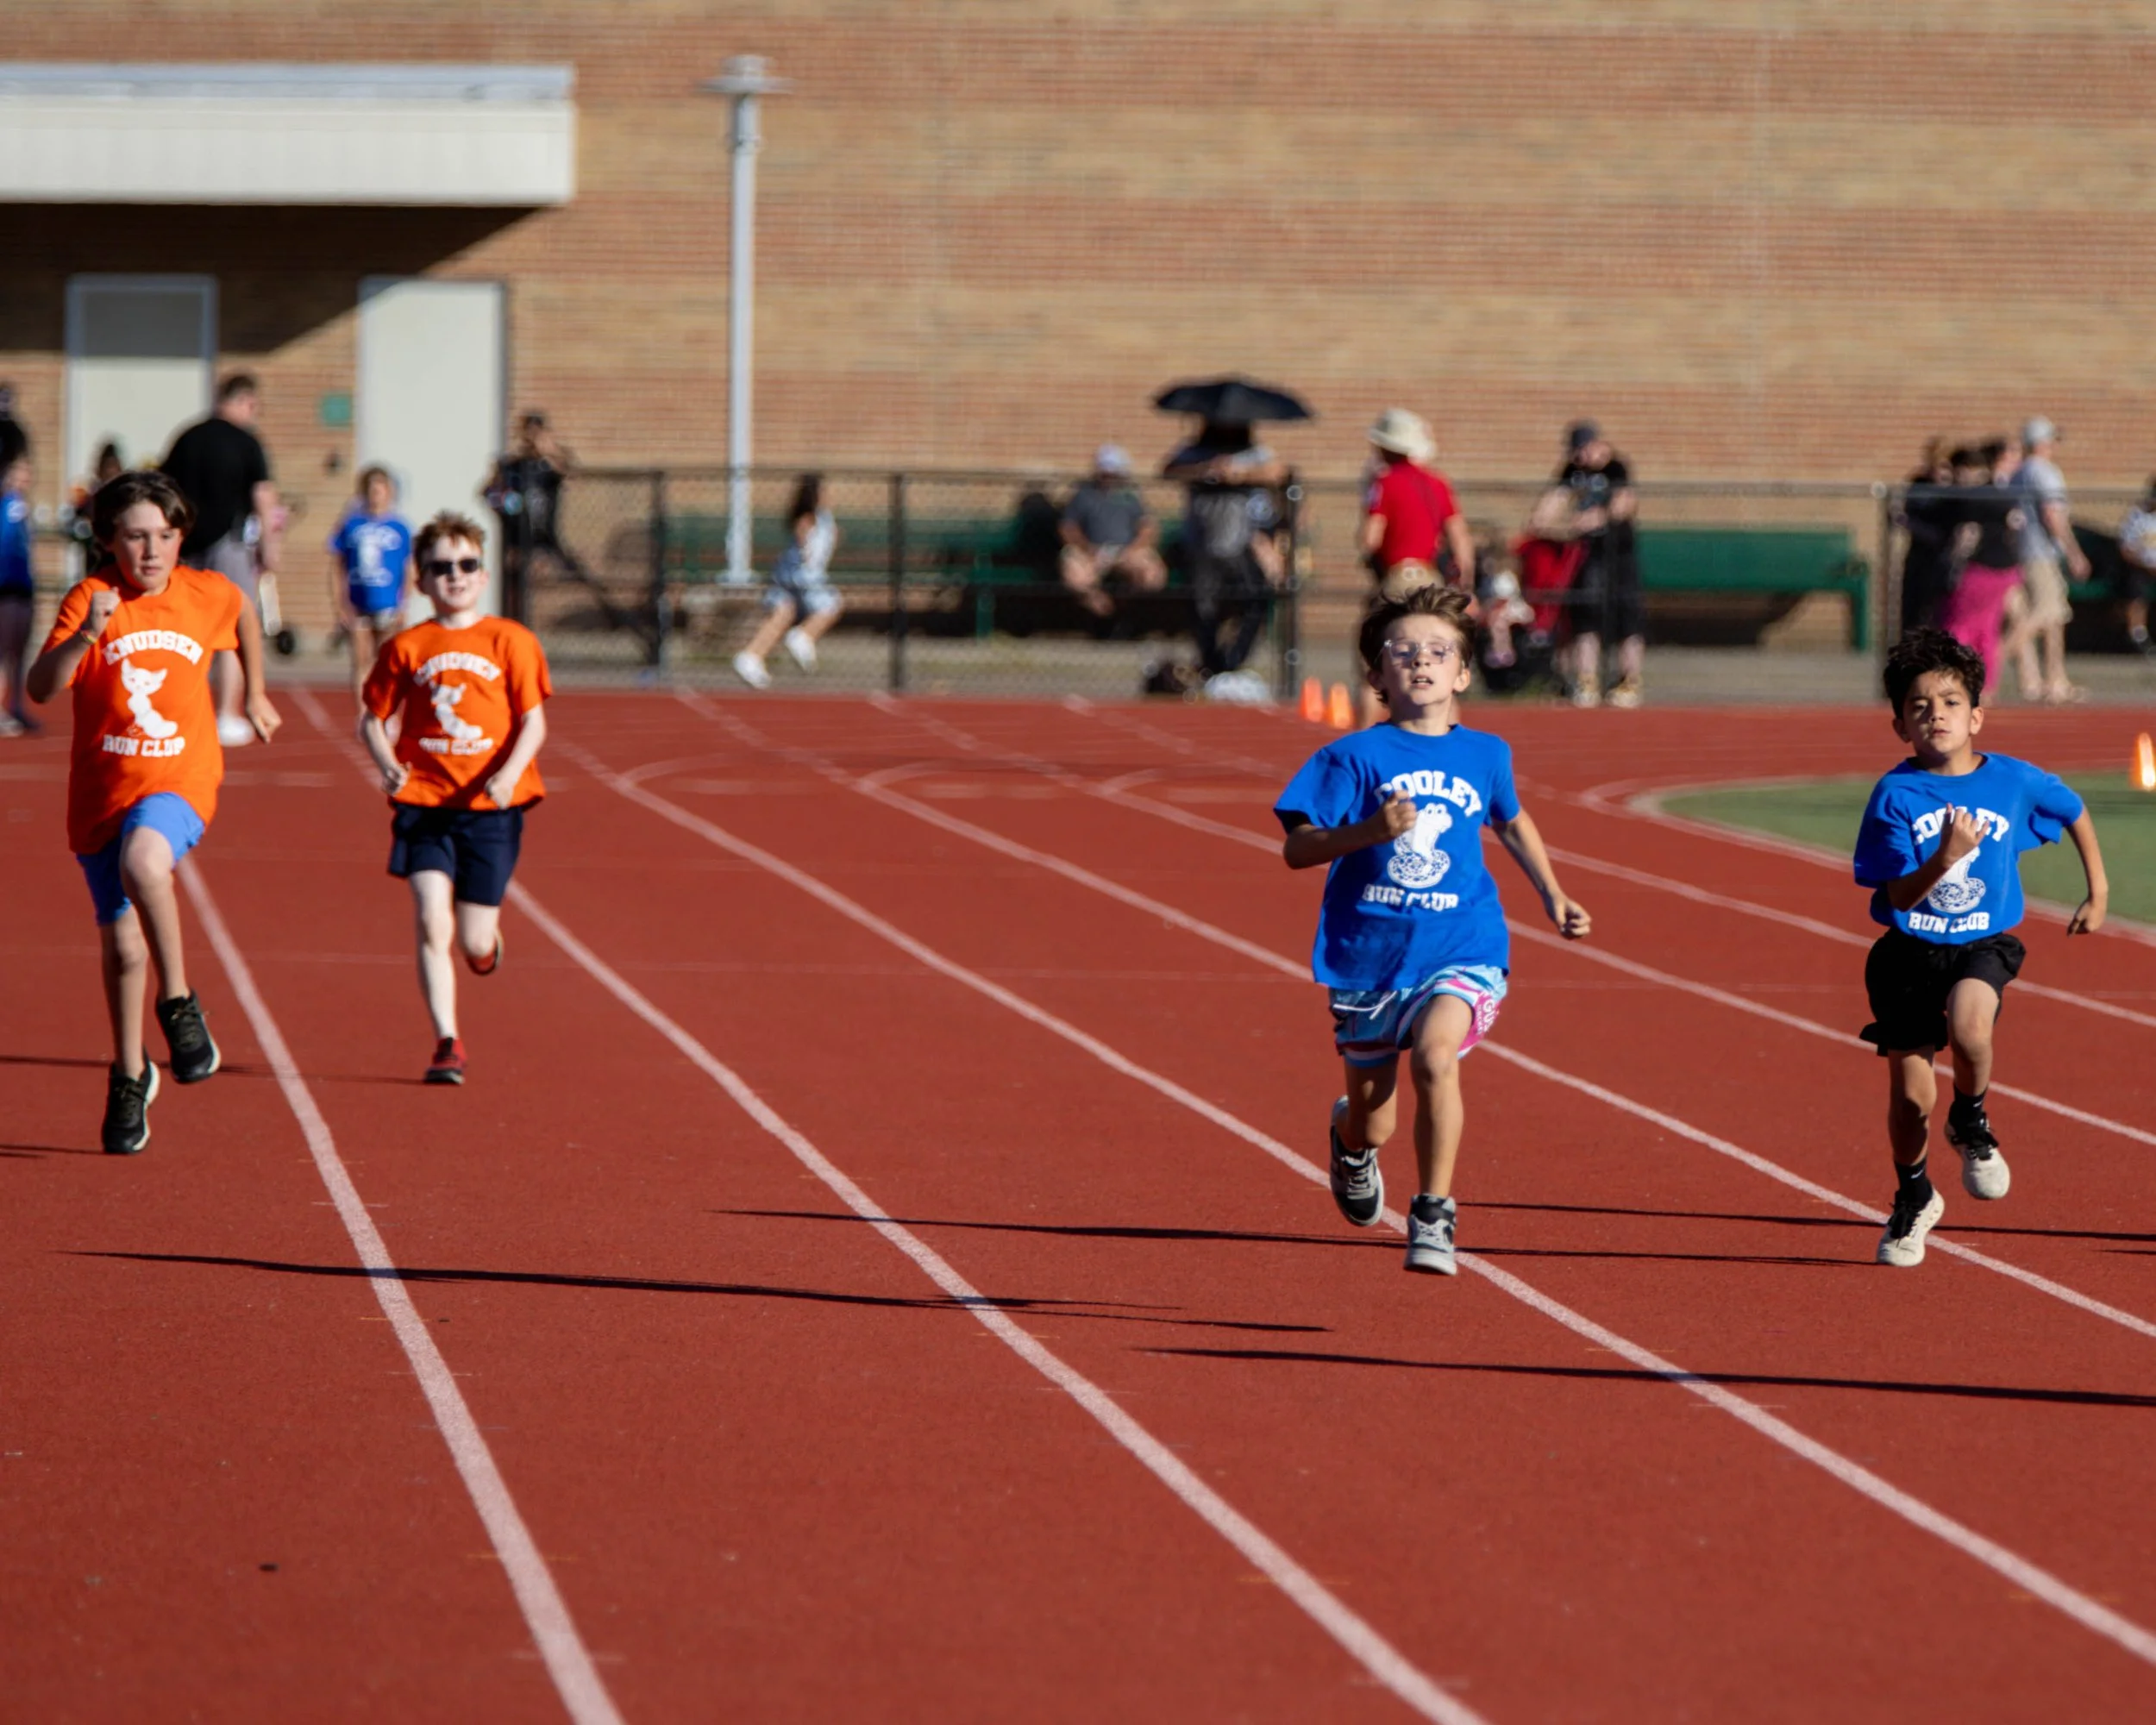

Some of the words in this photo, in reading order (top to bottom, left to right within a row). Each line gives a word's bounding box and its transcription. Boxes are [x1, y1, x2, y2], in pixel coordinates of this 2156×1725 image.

[104, 630, 204, 665] KNUDSEN
[103, 734, 140, 756] RUN
[1908, 912, 1948, 934] RUN
